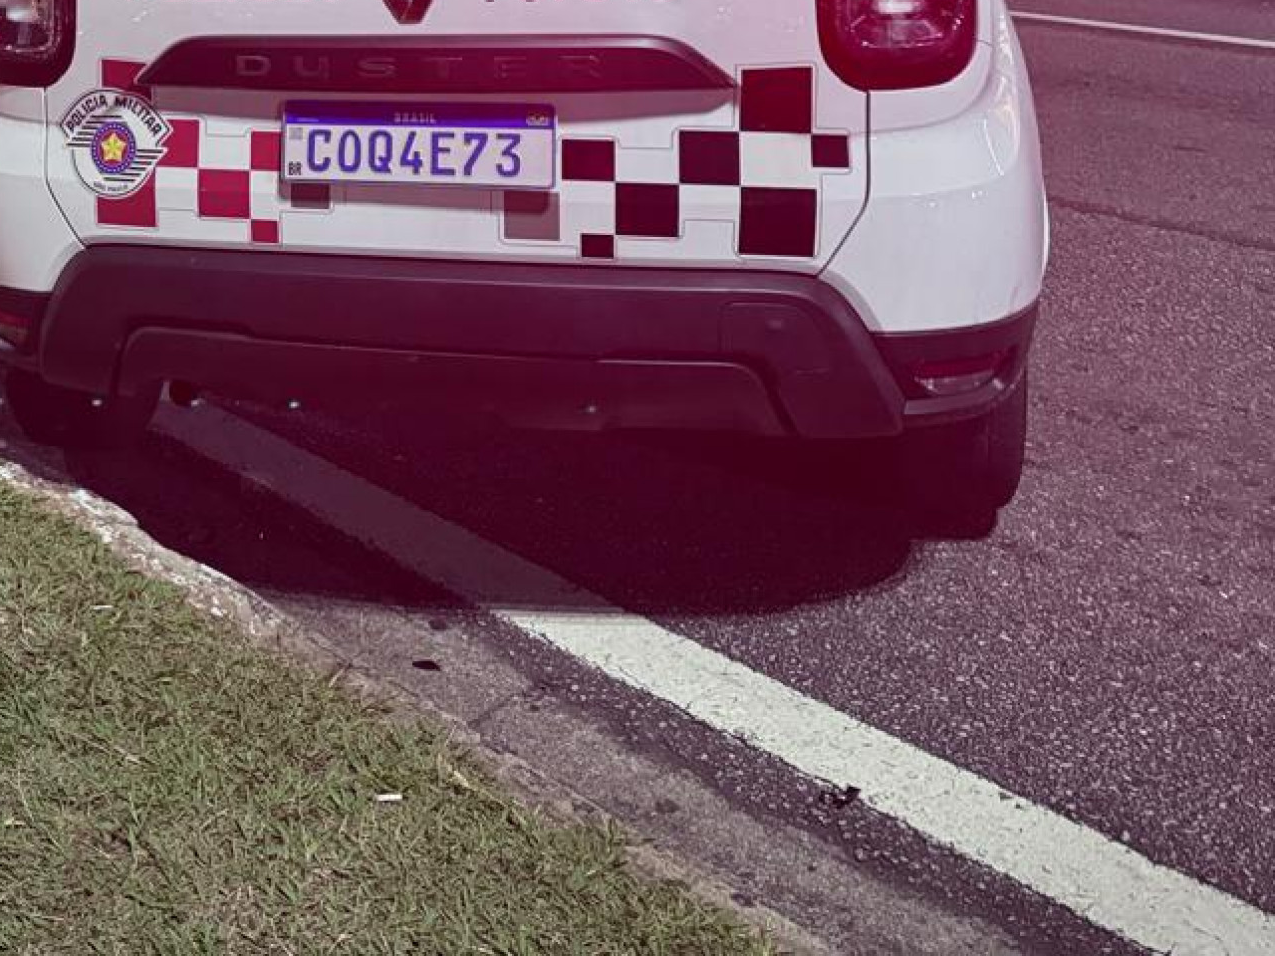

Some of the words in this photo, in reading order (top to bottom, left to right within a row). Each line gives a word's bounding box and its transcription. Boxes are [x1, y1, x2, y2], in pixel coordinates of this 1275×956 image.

[235, 54, 605, 79] DUSTER
[115, 95, 163, 137] MILITAR
[288, 161, 302, 177] BR
[306, 128, 522, 178] COQ4E73
